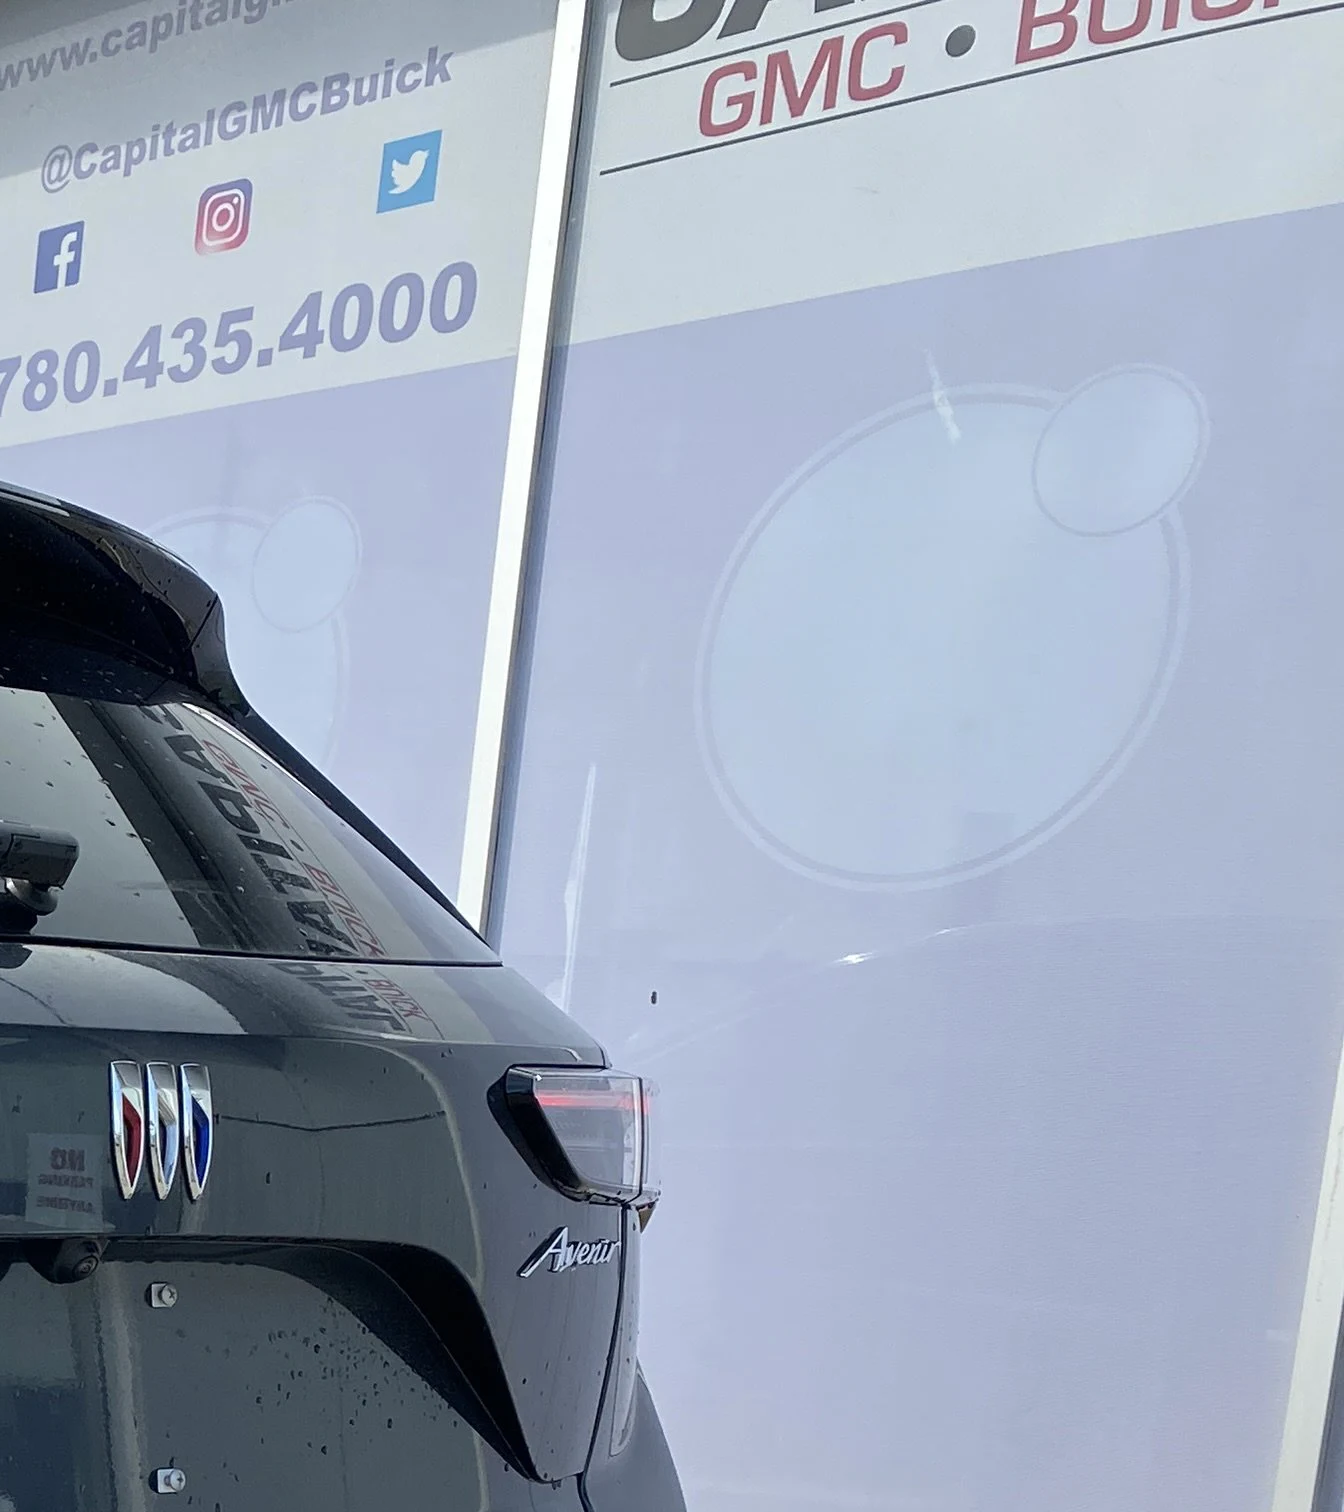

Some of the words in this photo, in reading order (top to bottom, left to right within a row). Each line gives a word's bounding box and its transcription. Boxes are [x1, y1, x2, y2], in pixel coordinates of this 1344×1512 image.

[41, 45, 454, 193] @CapitalGMCBuick
[698, 20, 909, 138] GMC
[518, 1225, 622, 1278] Avenir
